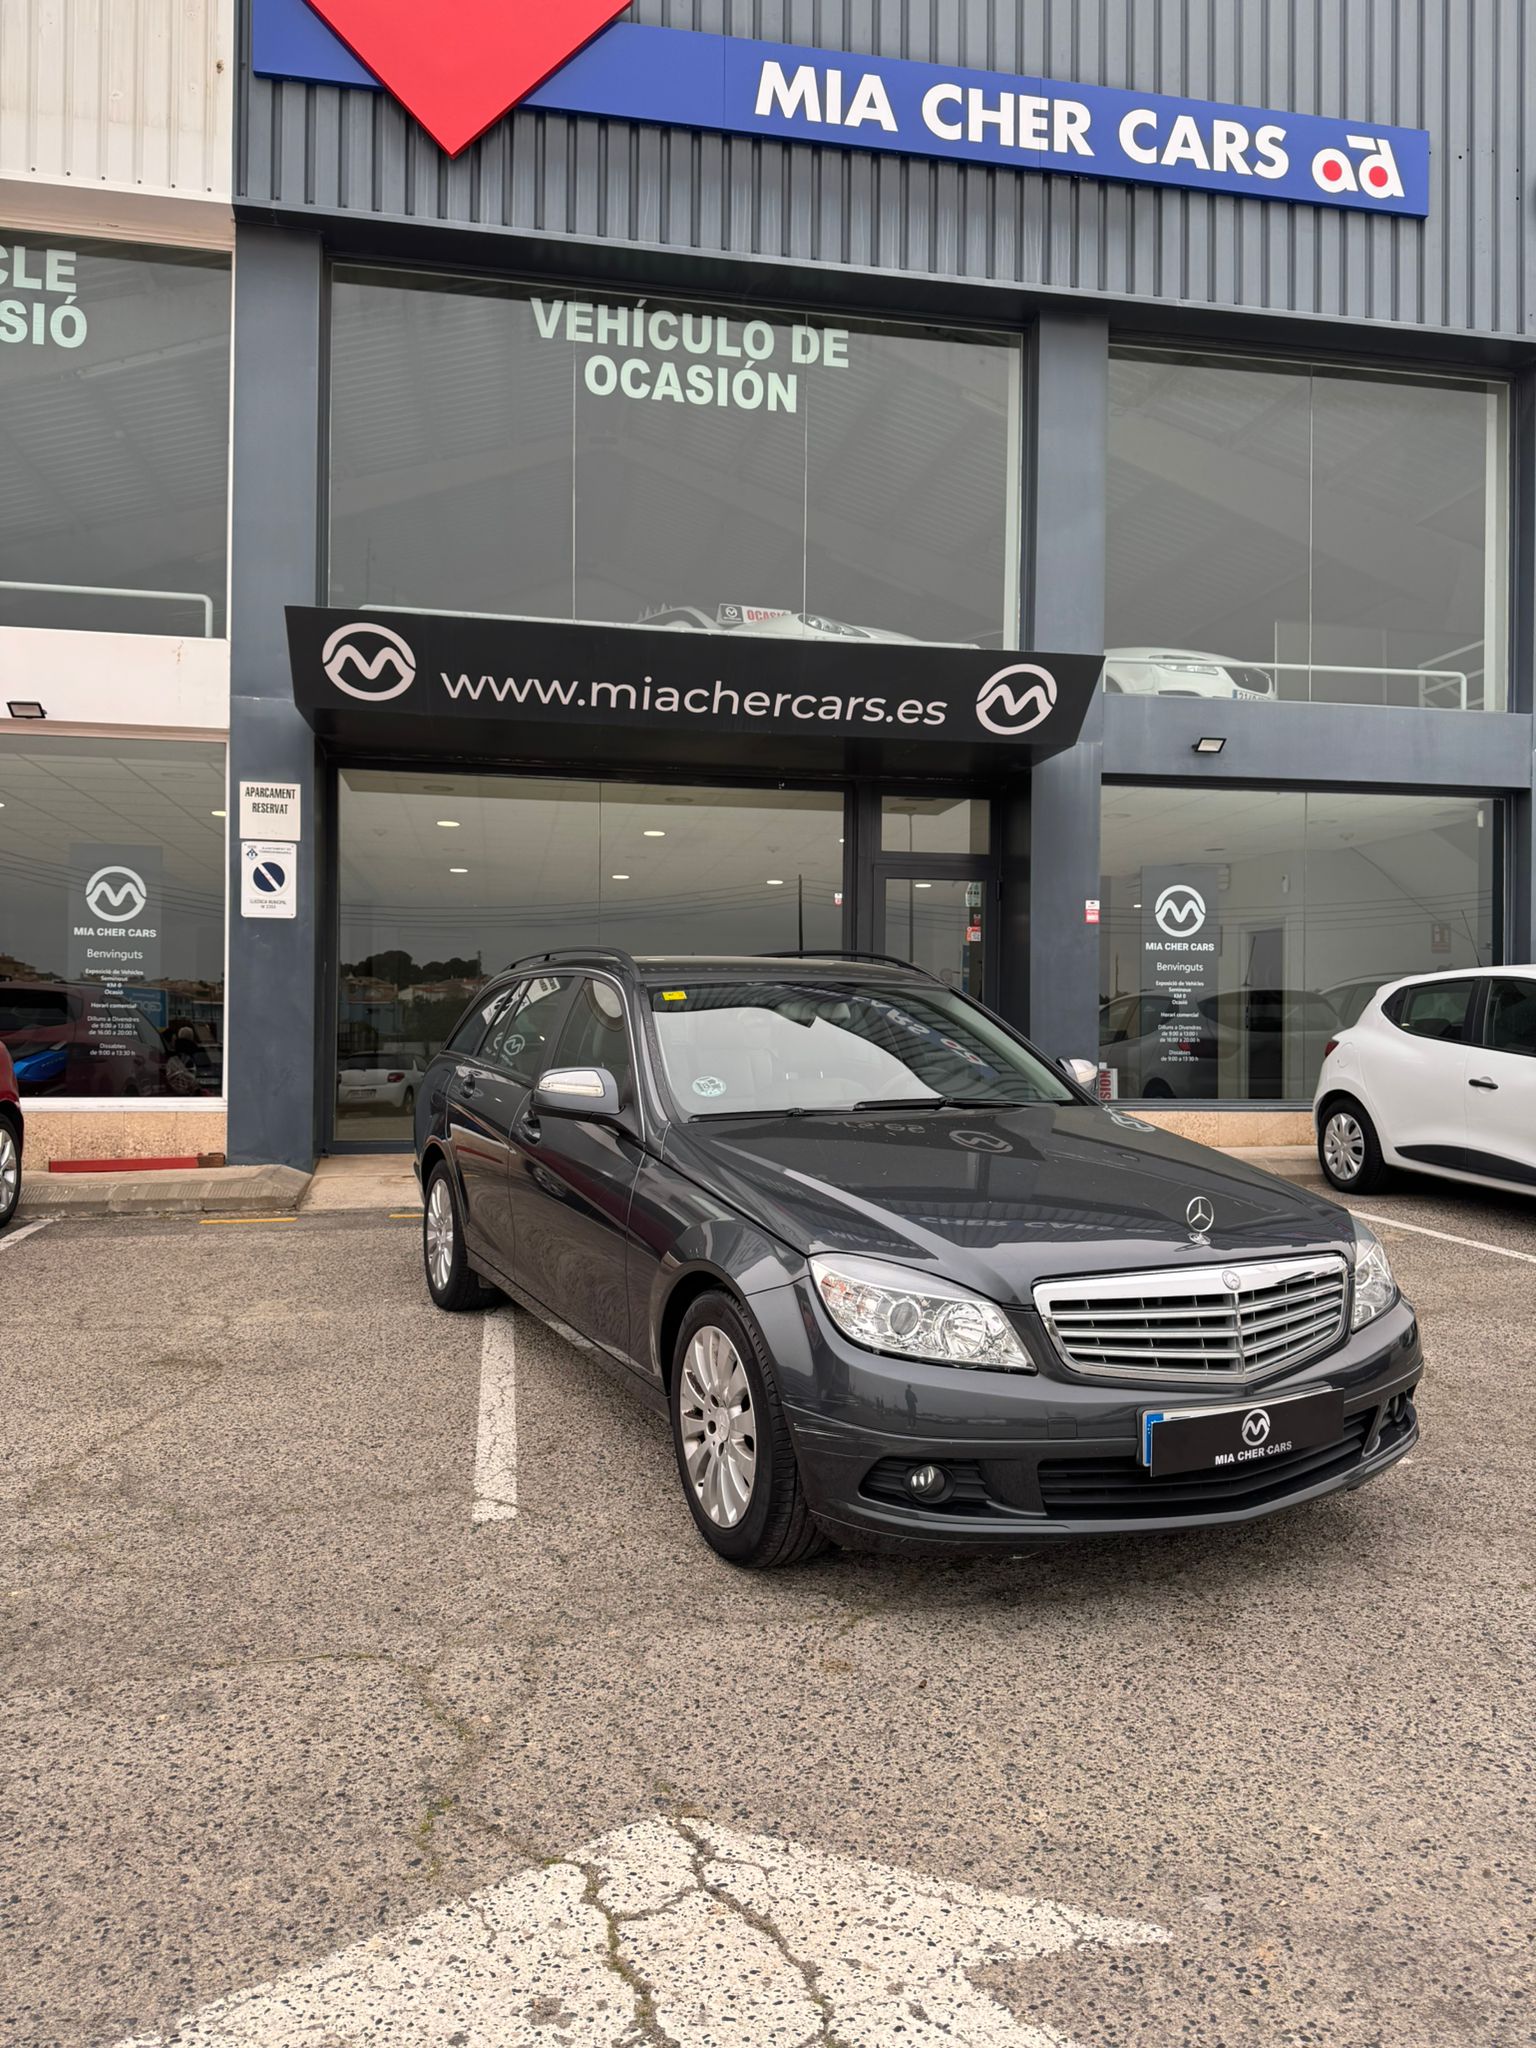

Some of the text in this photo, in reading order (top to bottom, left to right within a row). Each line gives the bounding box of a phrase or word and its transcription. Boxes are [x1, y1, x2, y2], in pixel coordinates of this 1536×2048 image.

[755, 60, 1289, 179] MIA CHER CARS
[530, 297, 849, 368] VEHÍCULO DE
[584, 354, 798, 413] OCASIÓN
[440, 672, 948, 726] www.miachercars.es
[245, 786, 296, 799] APARCAMENT
[252, 802, 288, 814] RESERVAT
[73, 927, 157, 938] MIA CHER CARS
[1145, 942, 1215, 952] MIA CHER CARS
[87, 948, 143, 961] Benvinguts
[1156, 962, 1204, 974] Benvinguts
[1215, 1440, 1293, 1466] MIA CHER CARS
